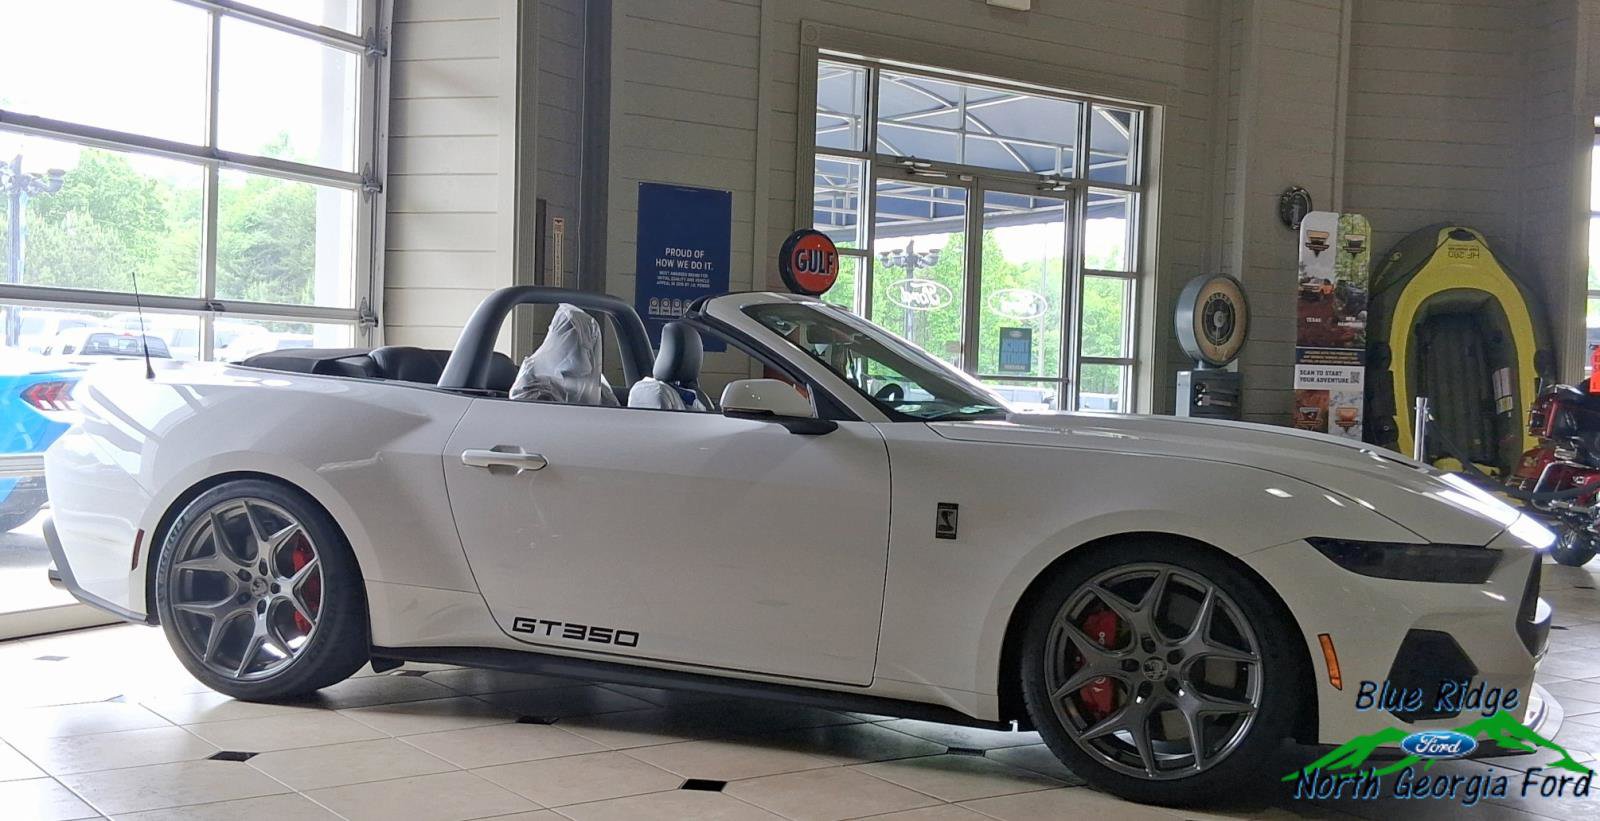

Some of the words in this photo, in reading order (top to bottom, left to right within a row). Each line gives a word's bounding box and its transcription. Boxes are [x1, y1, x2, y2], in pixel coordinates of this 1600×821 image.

[665, 247, 692, 258] PROUD
[694, 249, 705, 259] OF
[795, 249, 834, 276] GULF
[655, 258, 675, 268] HOW
[677, 260, 689, 269] WE
[691, 261, 702, 270] DO
[512, 616, 639, 647] GT350
